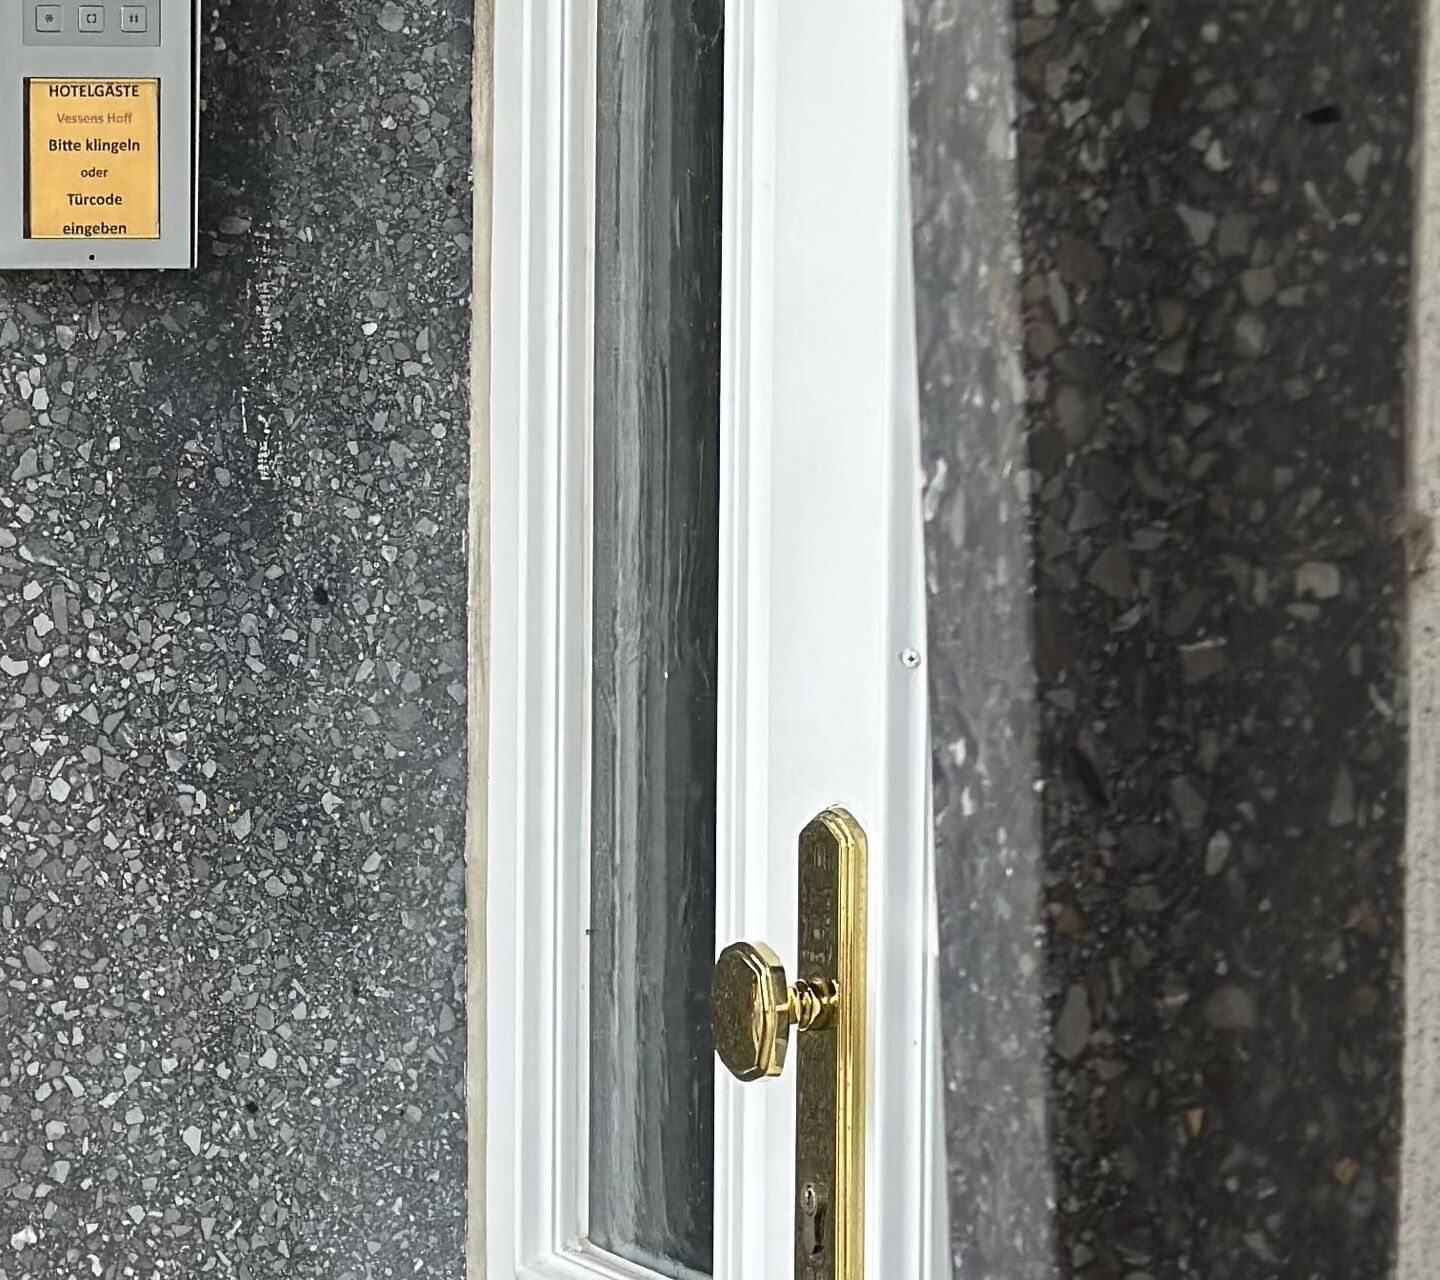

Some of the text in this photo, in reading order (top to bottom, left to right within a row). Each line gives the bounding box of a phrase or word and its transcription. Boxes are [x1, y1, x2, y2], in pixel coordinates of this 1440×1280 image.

[49, 83, 140, 97] HOTELGÄSTE
[57, 112, 133, 124] Vessens Hoff
[48, 138, 140, 154] Bitte klingeln
[80, 166, 108, 178] oder
[67, 193, 123, 206] Türcode
[62, 221, 127, 236] eingeben
